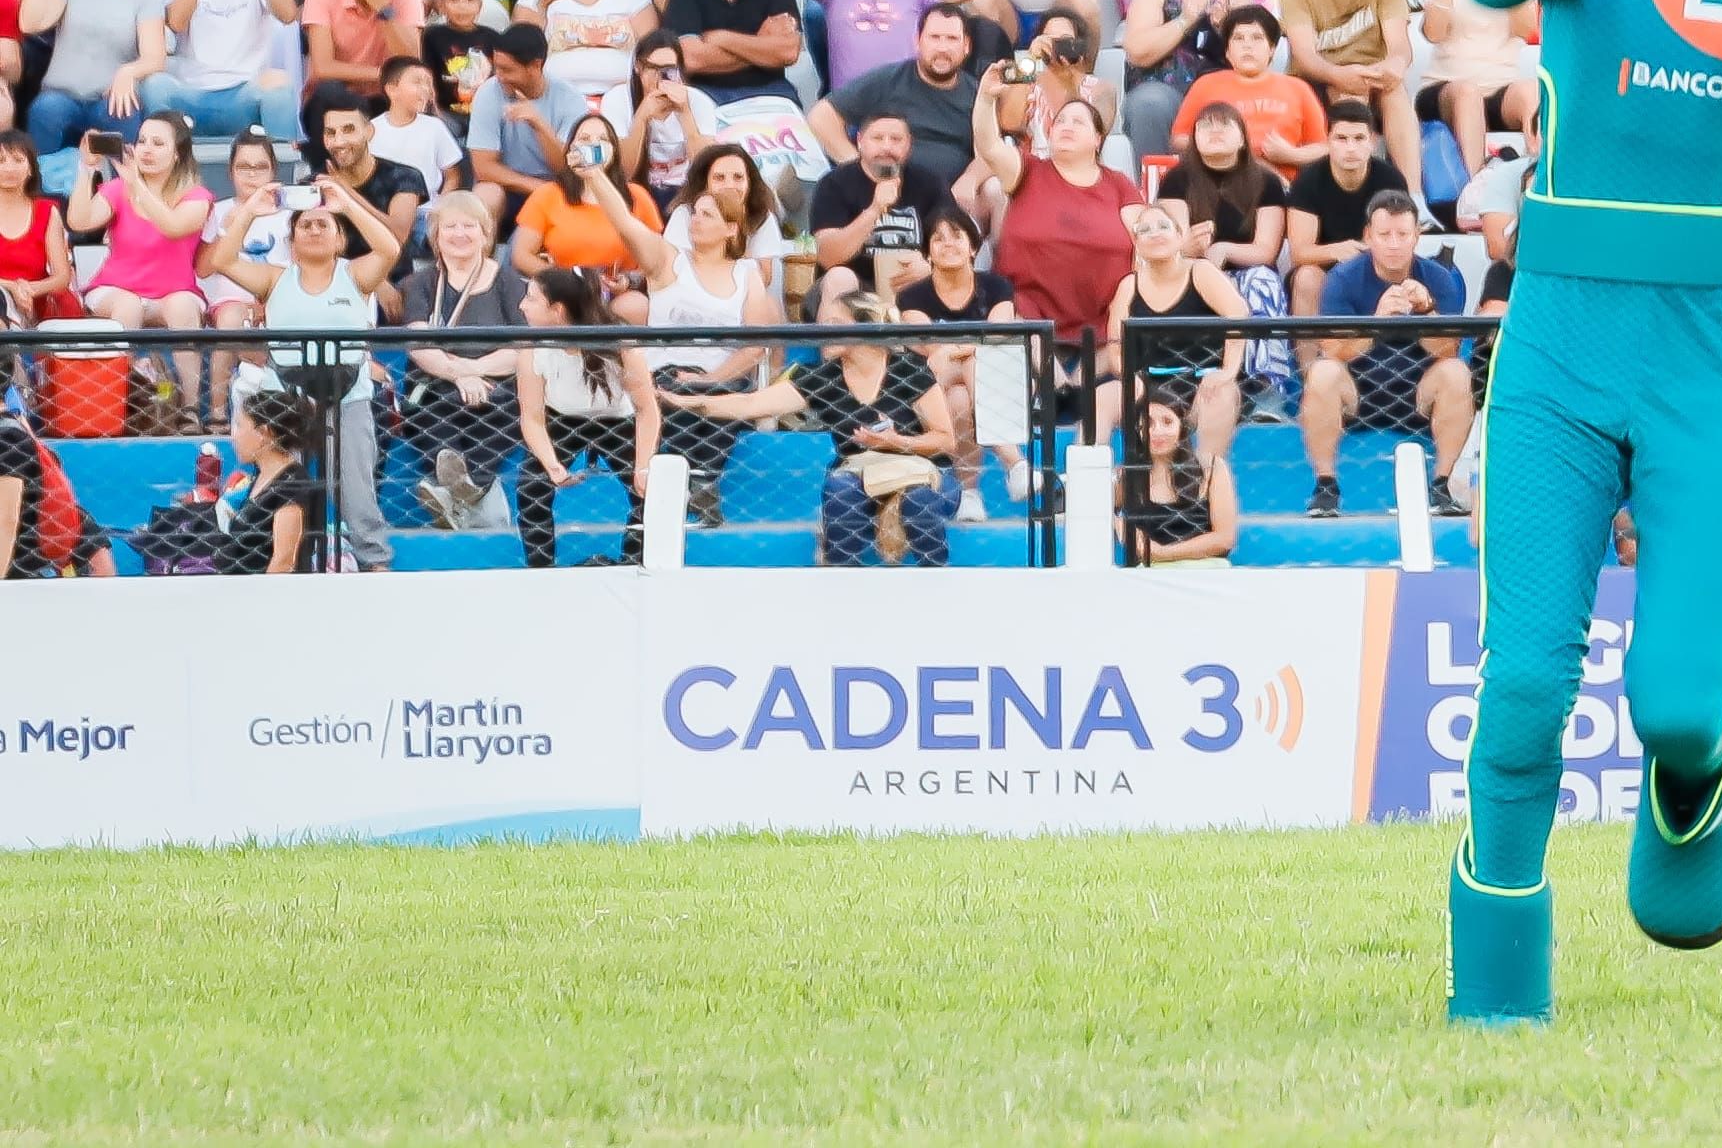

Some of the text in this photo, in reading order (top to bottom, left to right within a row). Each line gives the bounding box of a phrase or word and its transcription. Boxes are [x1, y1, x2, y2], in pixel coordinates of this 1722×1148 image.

[402, 698, 523, 728] Martín
[663, 663, 1245, 754] CADENA 3
[18, 716, 136, 762] Mejor
[248, 715, 373, 747] Gestión
[402, 728, 553, 765] Llaryora
[848, 769, 1135, 796] ARGENTINA
